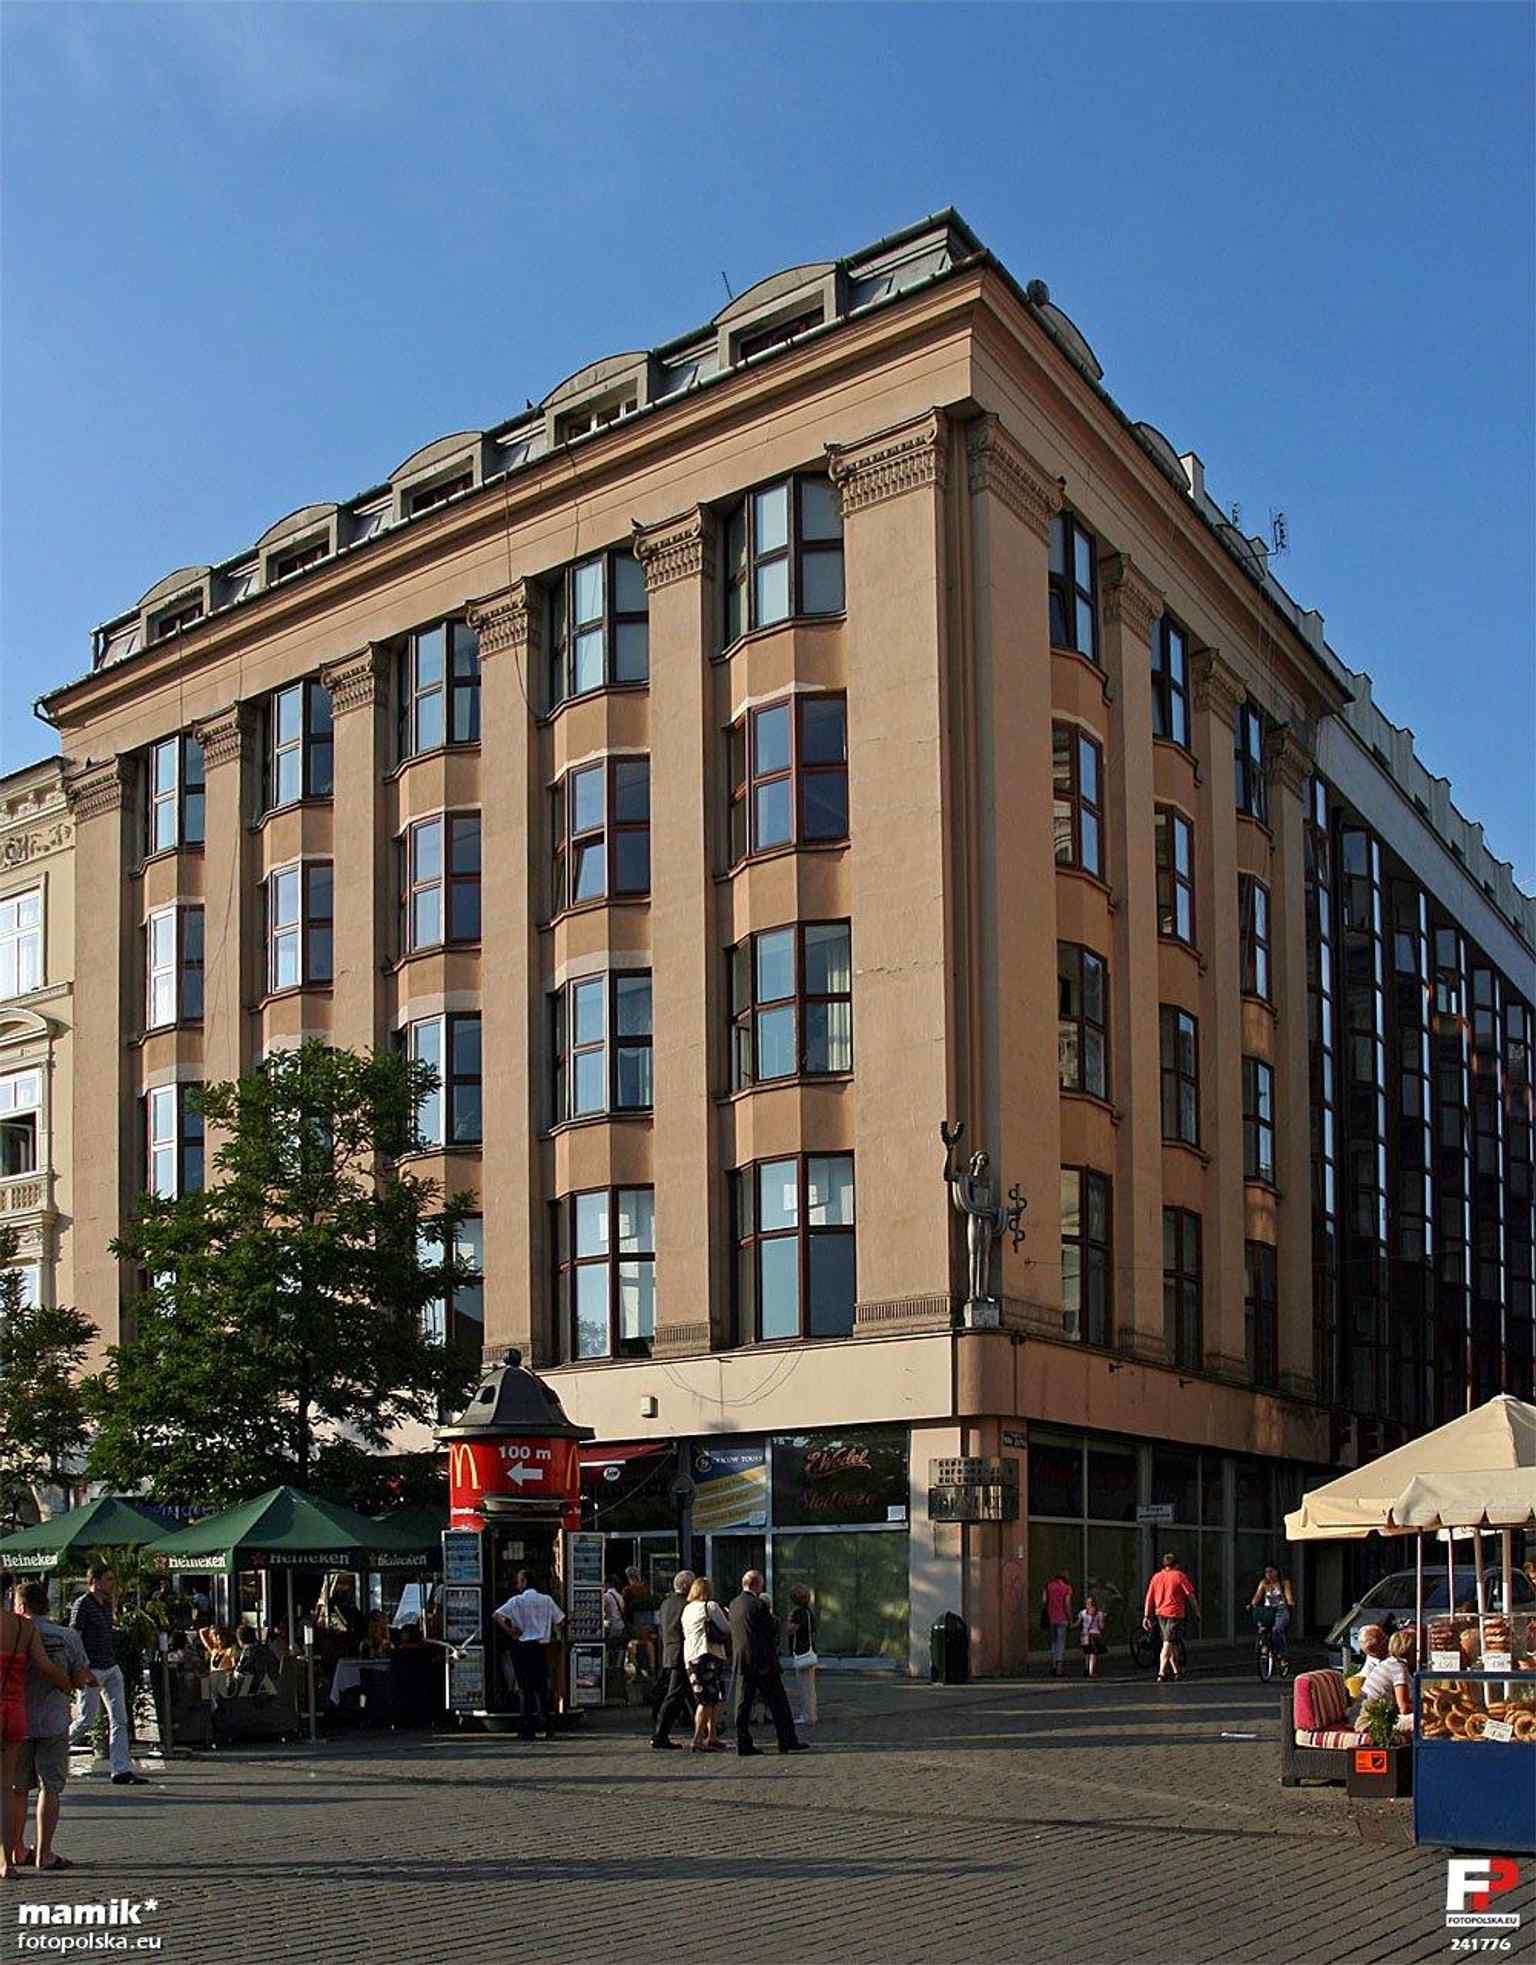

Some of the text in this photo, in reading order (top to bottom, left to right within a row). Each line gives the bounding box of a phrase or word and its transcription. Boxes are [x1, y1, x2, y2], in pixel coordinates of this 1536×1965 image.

[499, 1446, 551, 1460] 100 m
[1, 1552, 59, 1568] Heineken
[168, 1552, 227, 1568] Heineken
[269, 1552, 350, 1566] Heineken
